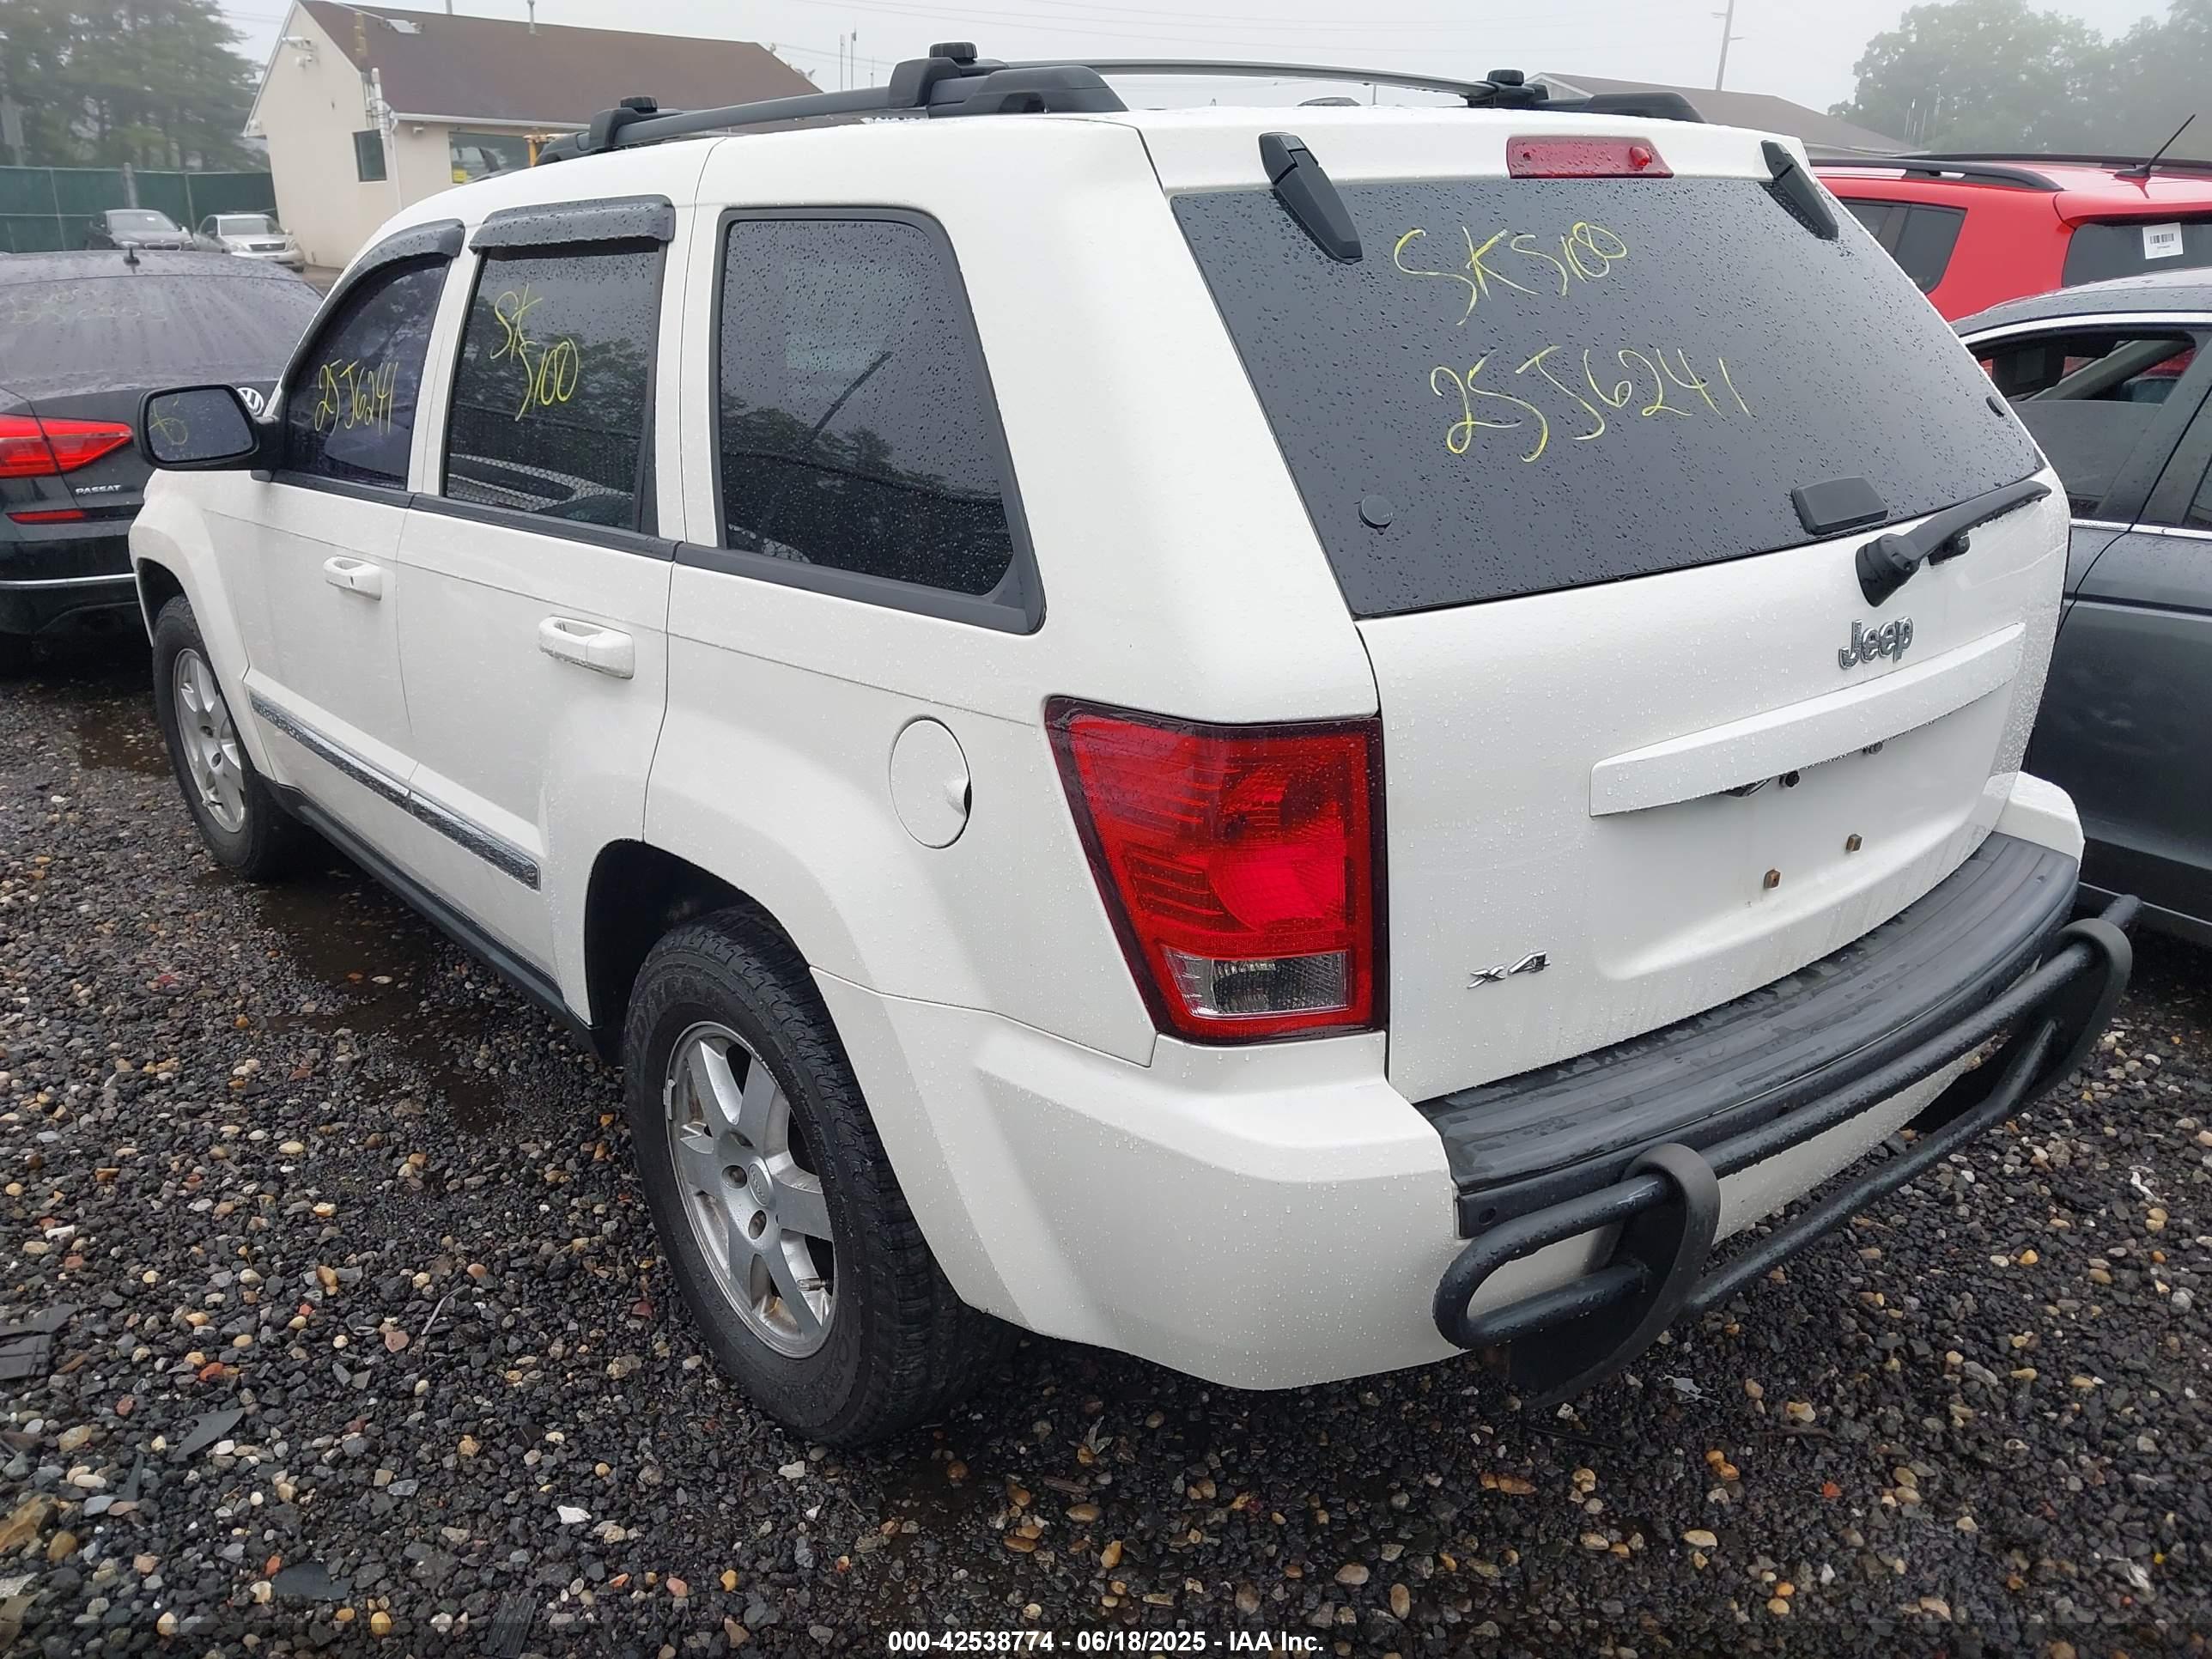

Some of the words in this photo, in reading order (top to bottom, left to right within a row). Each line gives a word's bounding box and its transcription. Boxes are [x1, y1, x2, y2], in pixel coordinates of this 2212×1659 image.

[1430, 344, 1752, 463] 25J6241
[75, 484, 122, 495] PASSAT
[1838, 617, 1914, 670] Jeep
